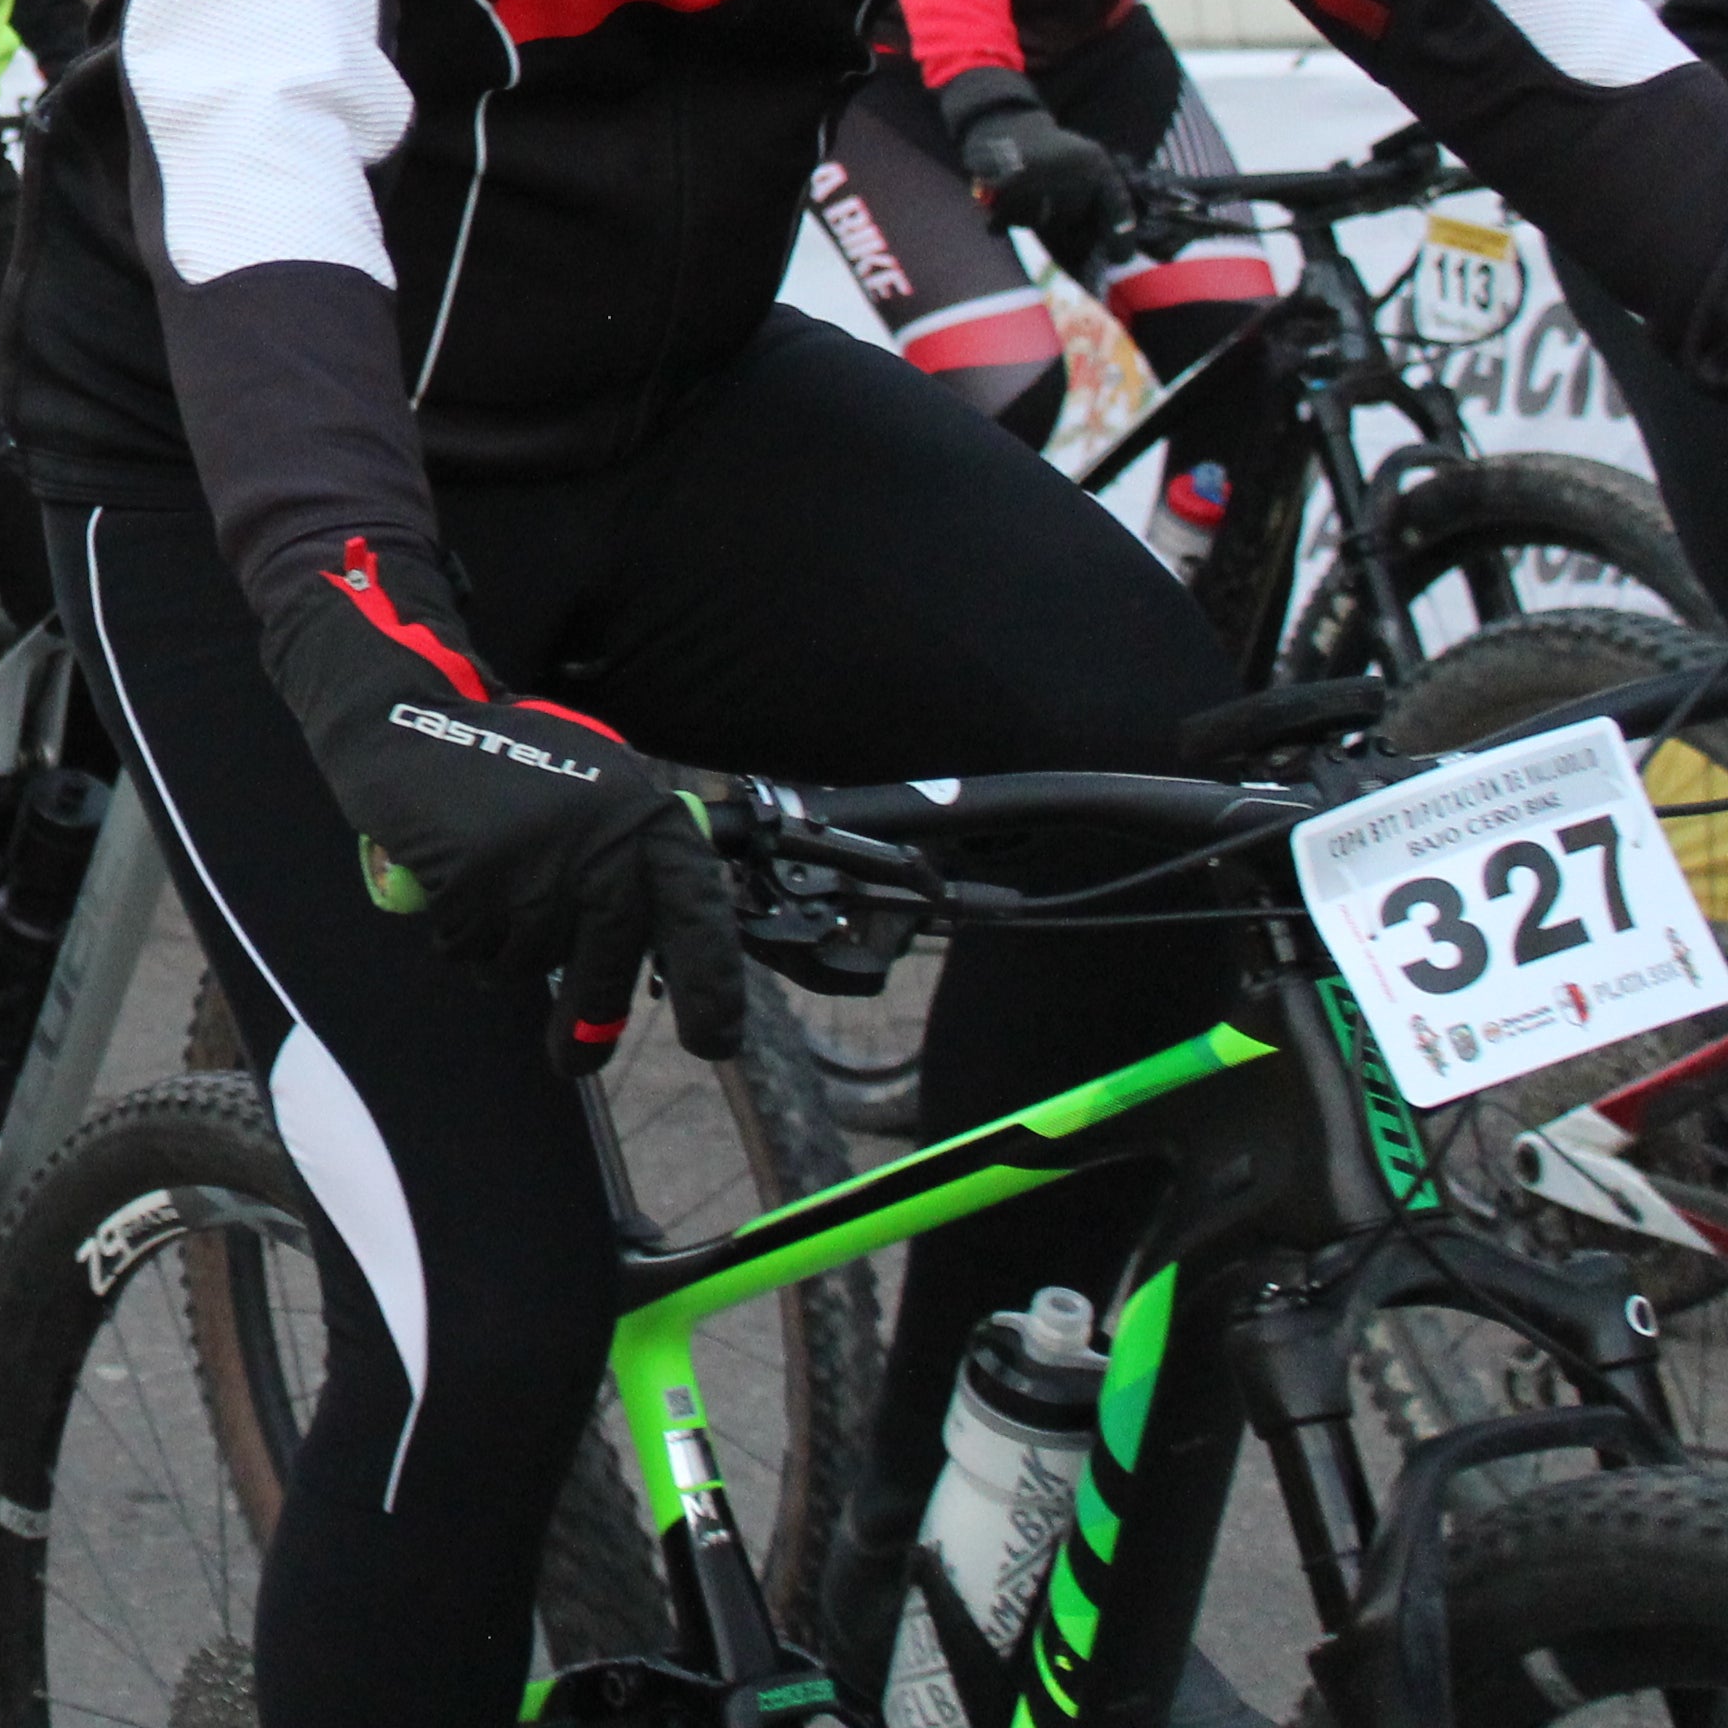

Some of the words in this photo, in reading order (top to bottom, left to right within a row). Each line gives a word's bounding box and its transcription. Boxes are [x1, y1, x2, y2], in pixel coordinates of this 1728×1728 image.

[1436, 252, 1496, 311] 113
[1407, 828, 1462, 858] BAJO
[1466, 805, 1524, 839] CERO
[1379, 814, 1638, 996] 327
